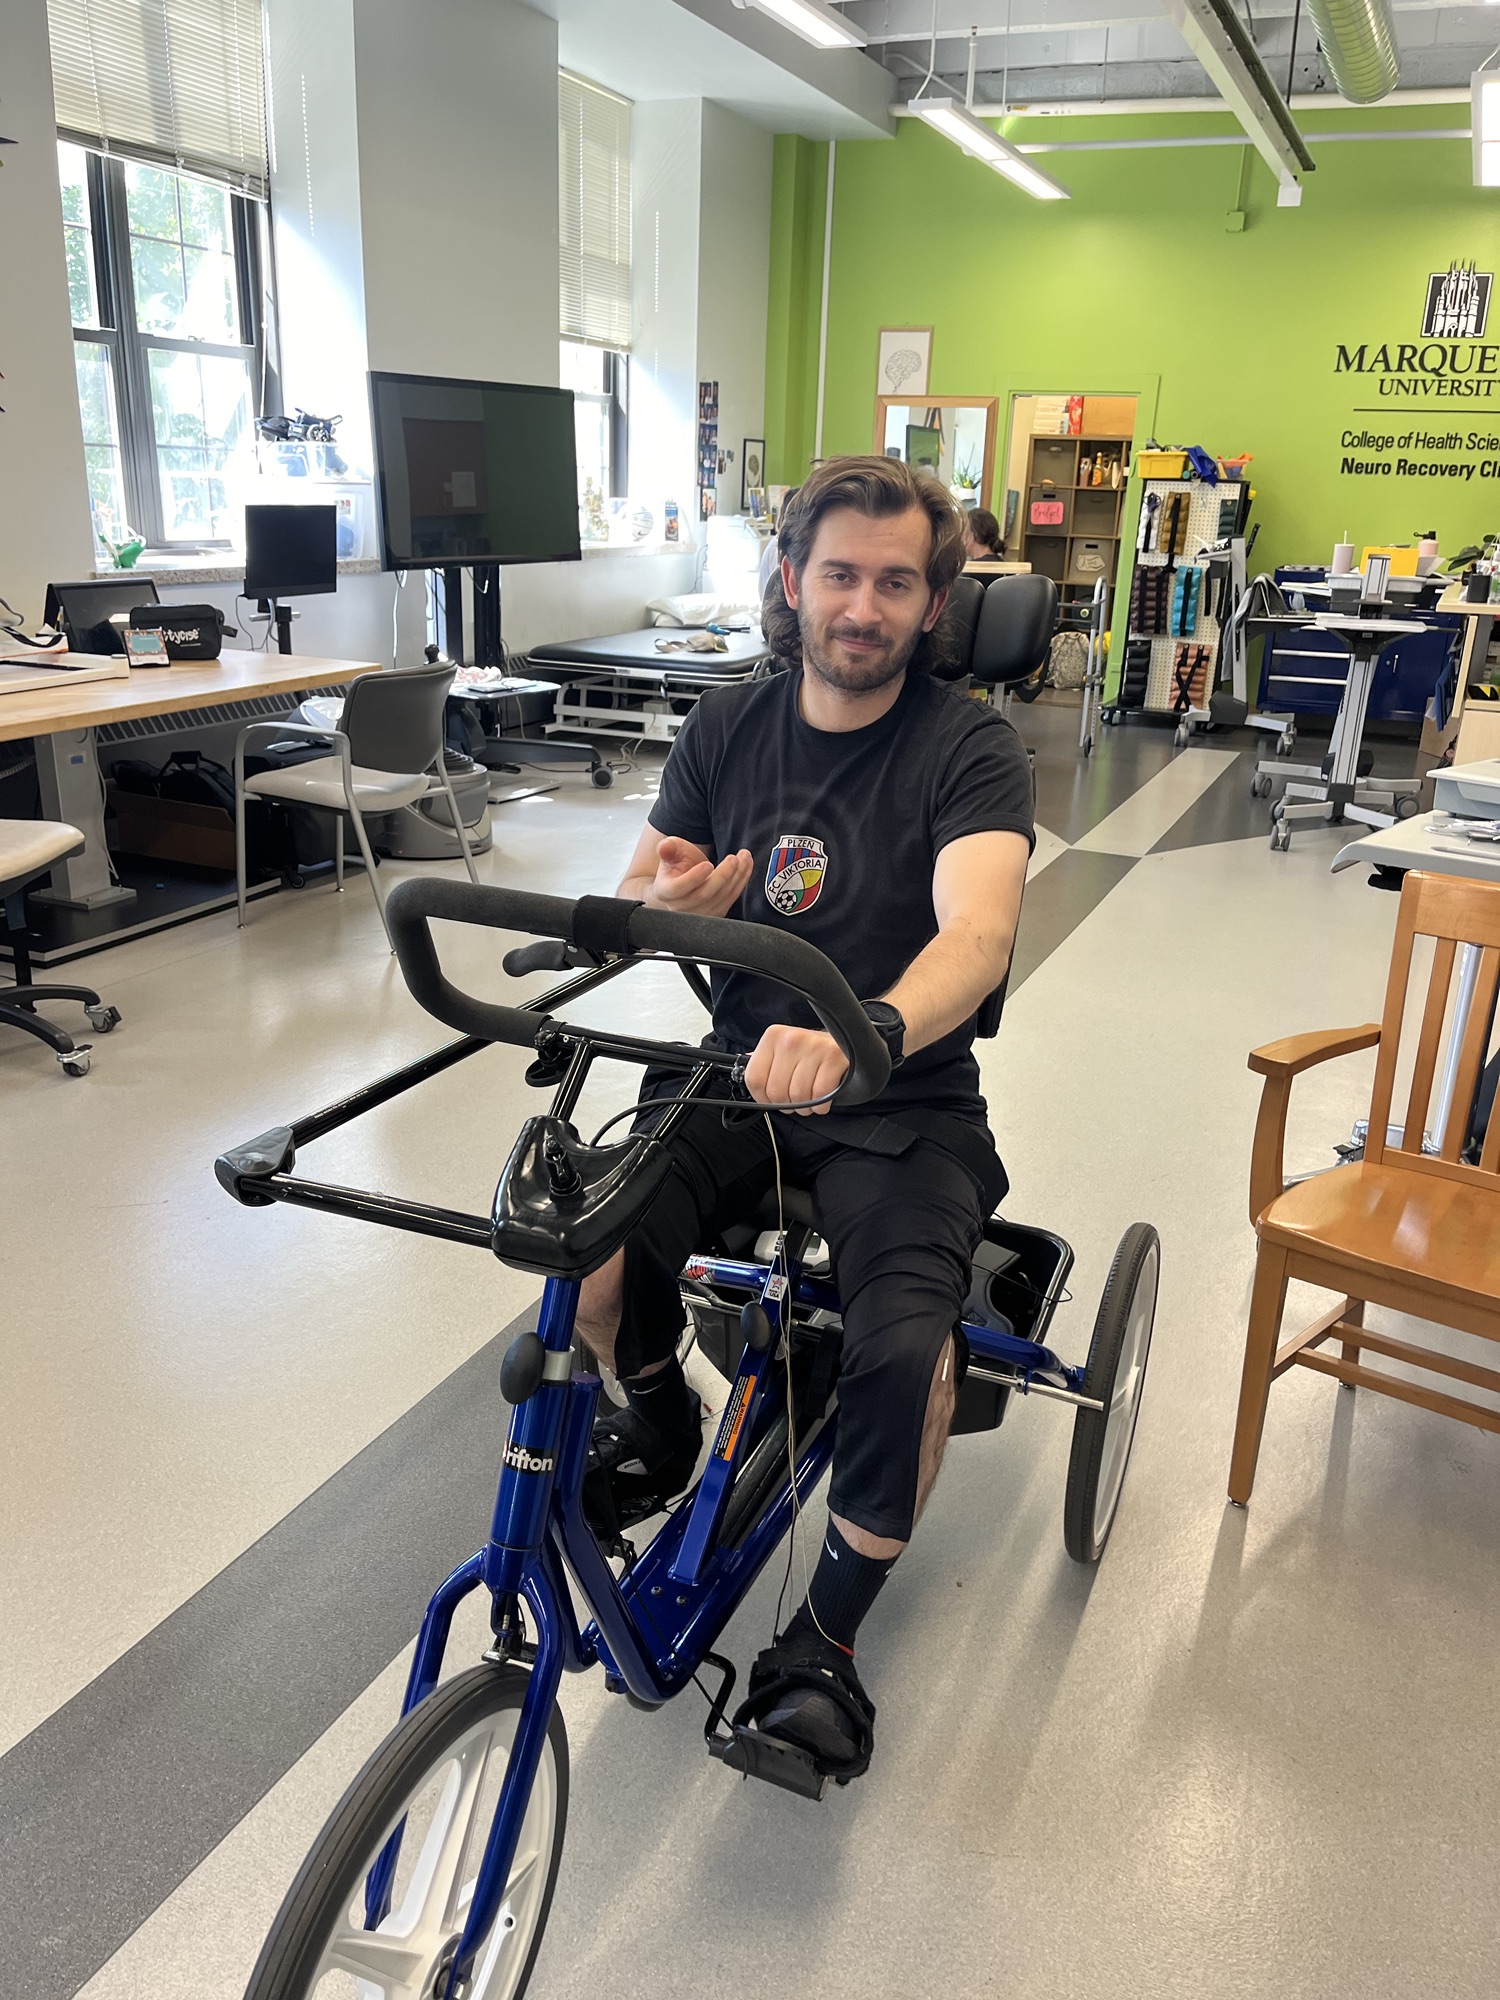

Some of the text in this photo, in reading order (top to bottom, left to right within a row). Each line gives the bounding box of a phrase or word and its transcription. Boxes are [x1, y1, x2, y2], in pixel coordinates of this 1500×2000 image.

[1333, 344, 1499, 377] MARQUE
[1378, 378, 1500, 397] UNIVERSIT
[1341, 431, 1500, 451] College of Health Scie
[1341, 458, 1391, 476] Neuro
[1396, 459, 1476, 481] Recovery
[787, 839, 815, 850] PLZEN
[769, 858, 822, 894] FC VIKTORIA
[505, 1446, 554, 1472] rifton
